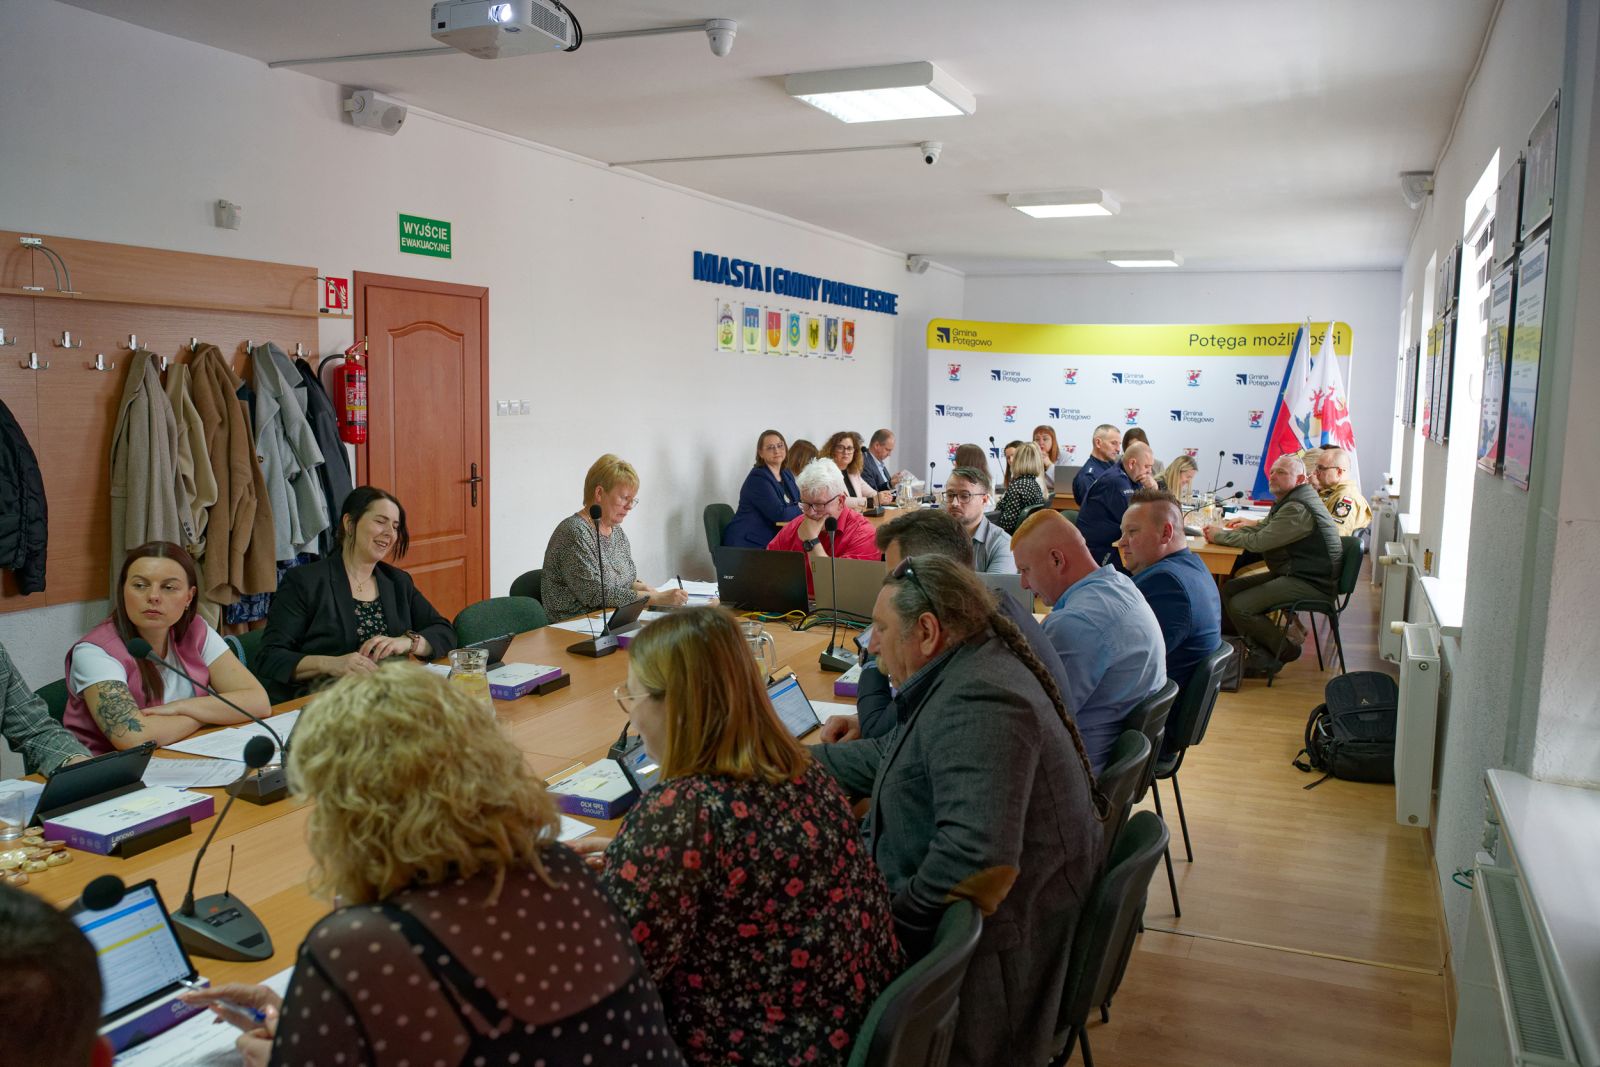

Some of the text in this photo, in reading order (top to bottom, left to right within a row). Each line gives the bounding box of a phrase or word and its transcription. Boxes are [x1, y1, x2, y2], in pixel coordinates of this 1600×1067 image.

[403, 222, 447, 240] WYJŚCIE
[401, 237, 450, 253] EWAKUACYJNE
[693, 250, 764, 291] MIASTA
[765, 266, 772, 293] I
[773, 267, 822, 301] GMINY
[952, 328, 977, 337] Gmina
[952, 336, 993, 347] Potęgowo
[1189, 333, 1247, 350] Potęga
[111, 830, 135, 843] Lenovo
